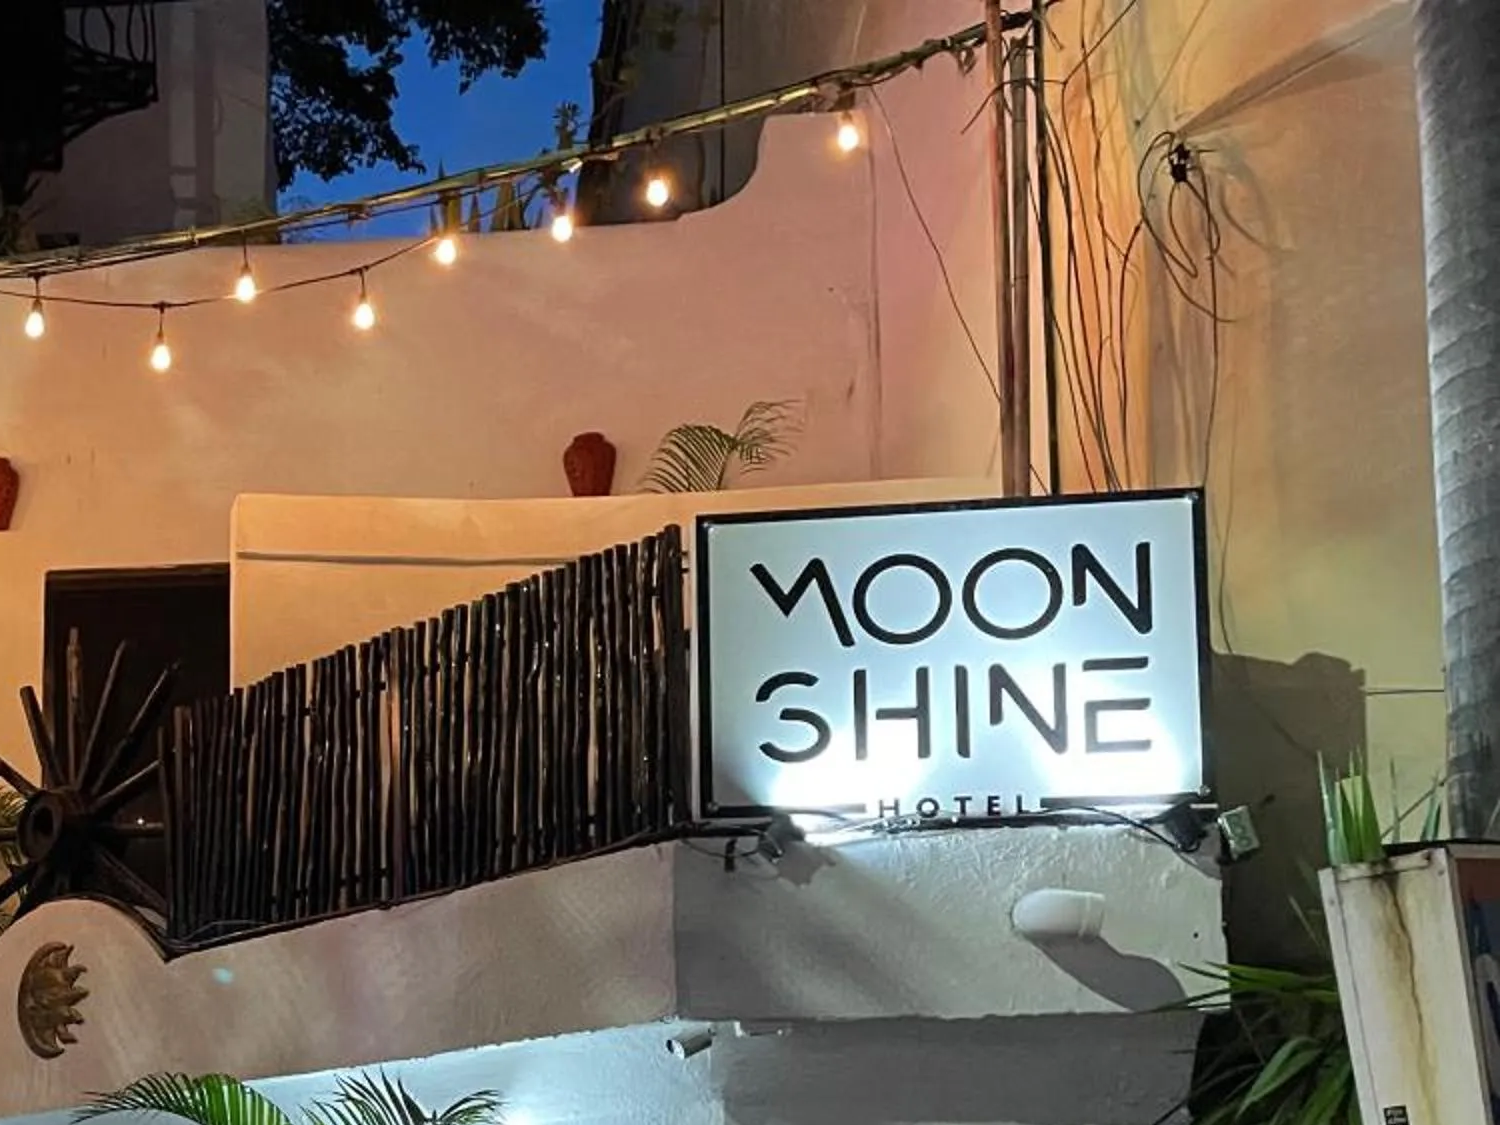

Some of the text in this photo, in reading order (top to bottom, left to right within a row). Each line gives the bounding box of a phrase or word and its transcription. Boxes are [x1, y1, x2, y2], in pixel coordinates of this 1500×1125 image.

[749, 541, 1153, 648] MOON
[755, 656, 1152, 763] SHINE
[878, 793, 1029, 818] HOTEL
